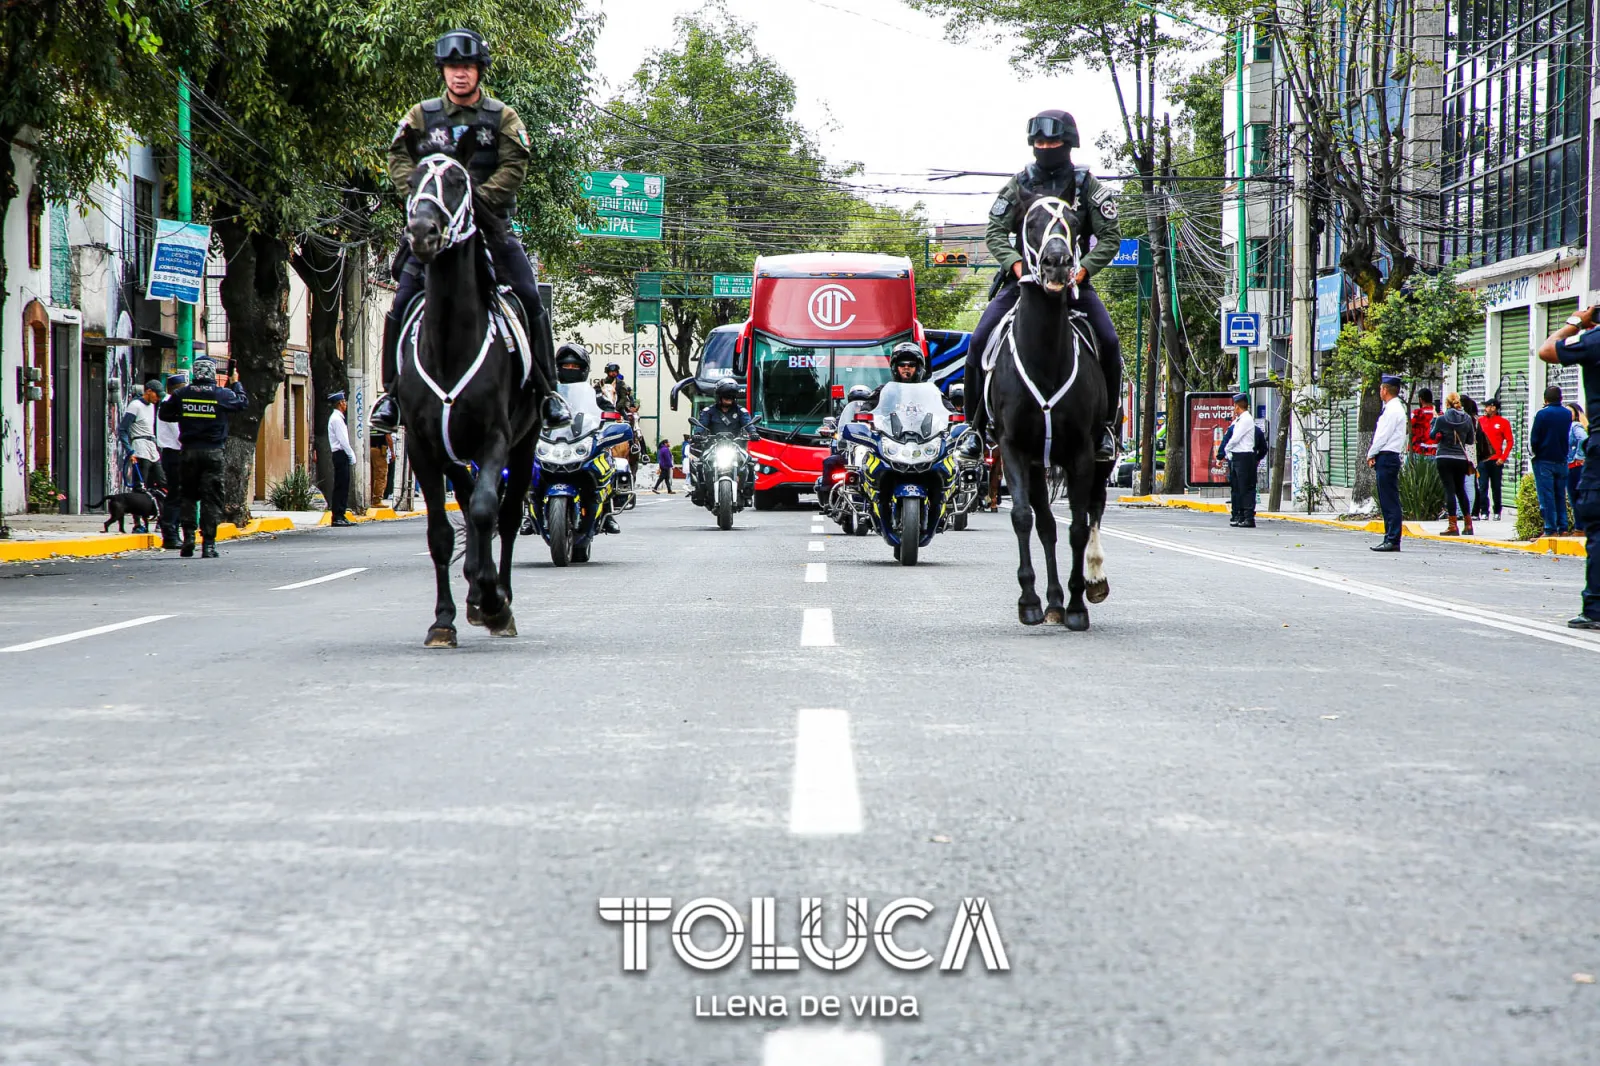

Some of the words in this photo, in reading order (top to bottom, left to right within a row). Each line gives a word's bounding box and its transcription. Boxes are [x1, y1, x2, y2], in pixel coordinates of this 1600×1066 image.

[649, 185, 657, 194] 15
[589, 195, 648, 214] GOBIERNO
[788, 355, 826, 368] BENZ
[182, 404, 216, 413] POLICÍA
